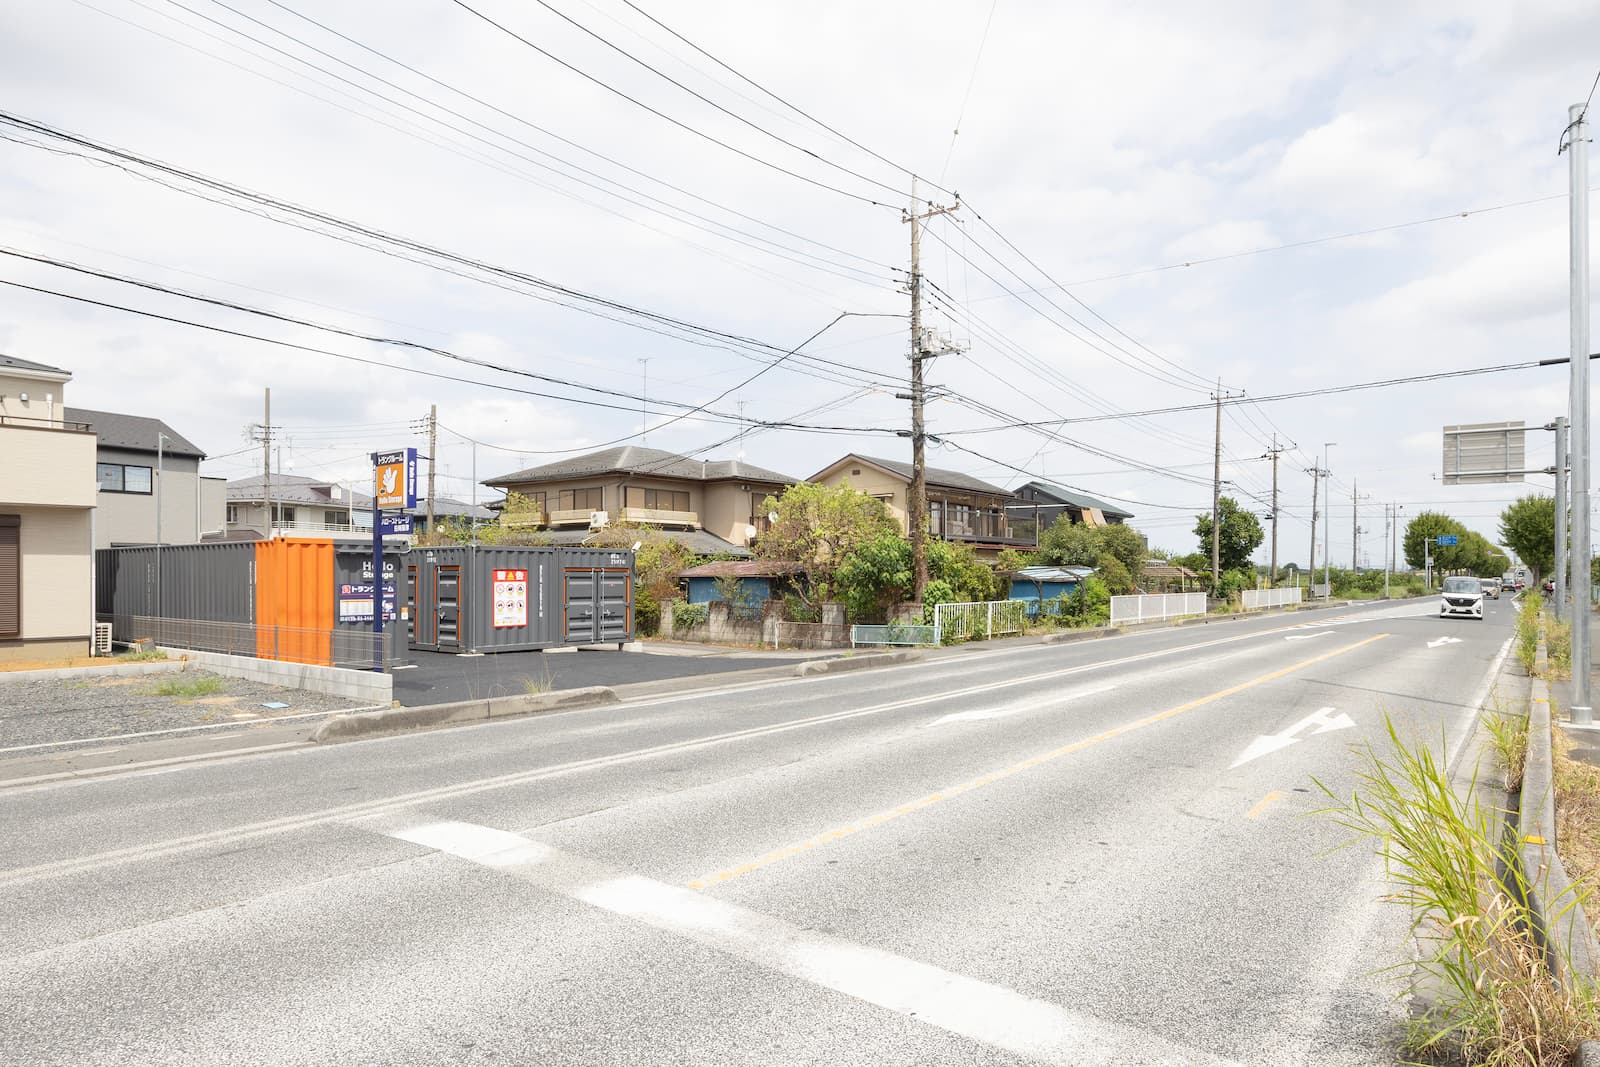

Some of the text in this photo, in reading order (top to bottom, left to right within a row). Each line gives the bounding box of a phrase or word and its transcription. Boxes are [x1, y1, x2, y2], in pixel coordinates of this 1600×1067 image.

[378, 454, 403, 464] トランクルーム
[363, 561, 393, 571] Hlo
